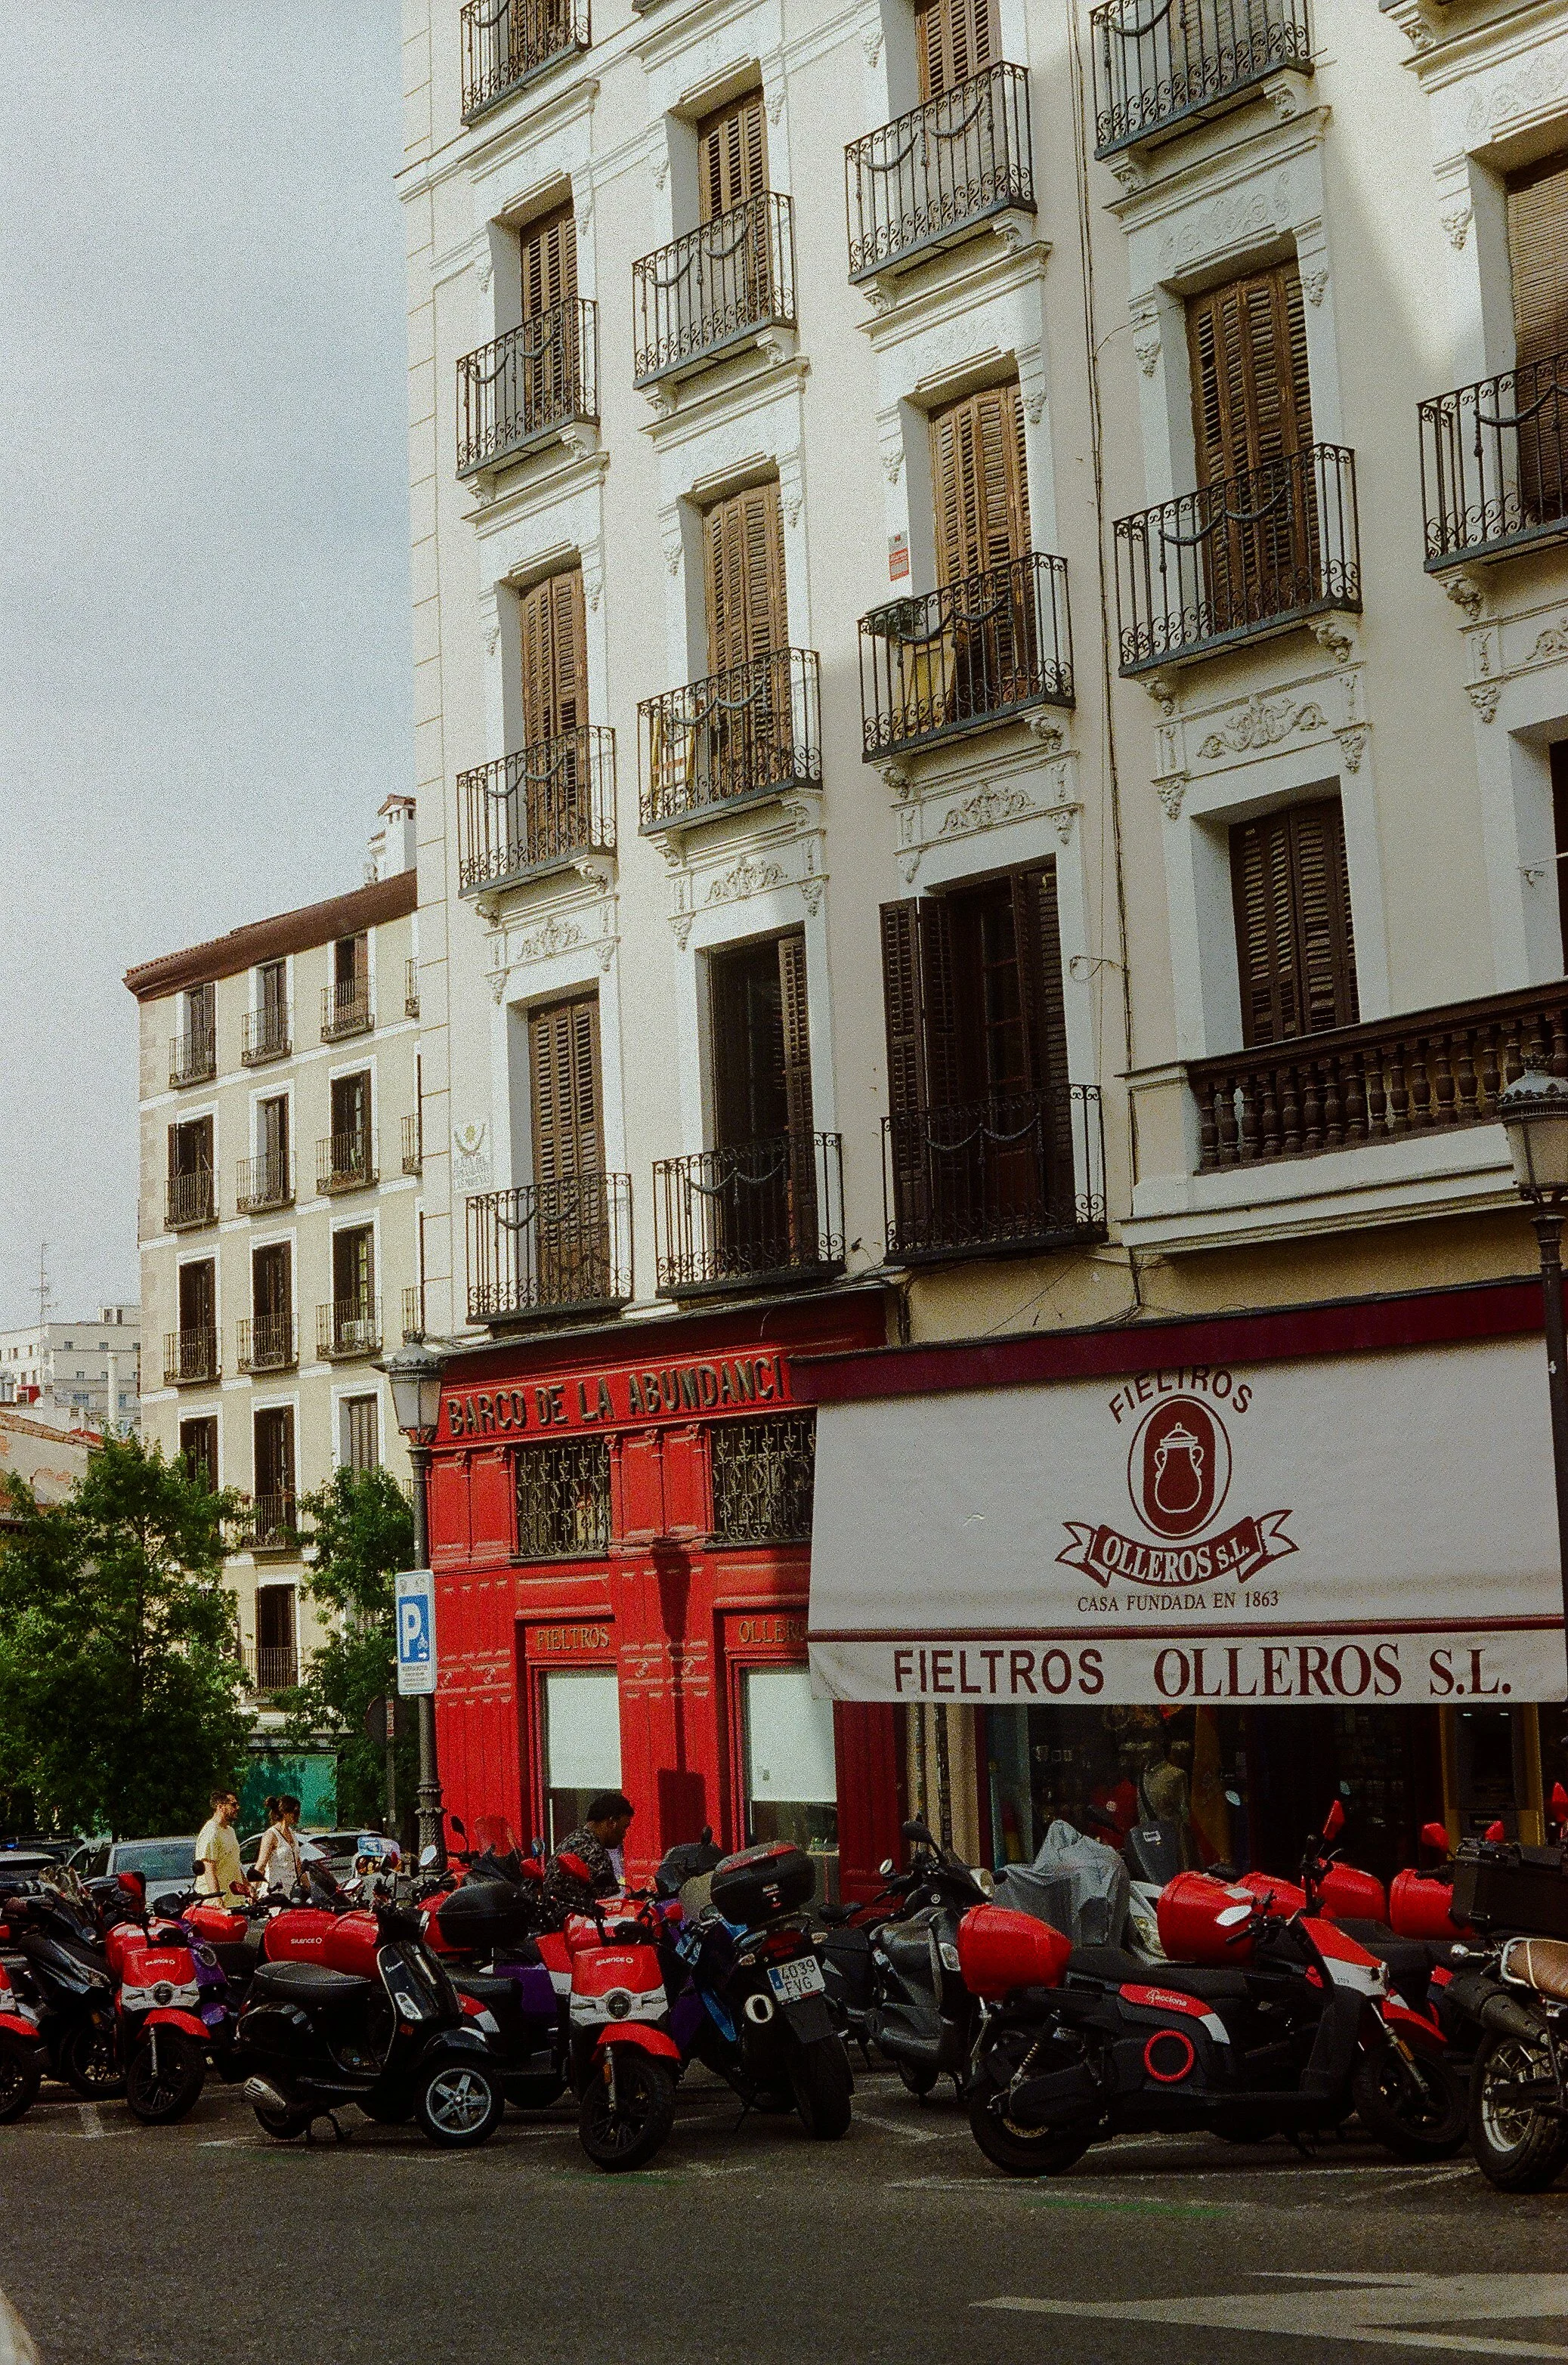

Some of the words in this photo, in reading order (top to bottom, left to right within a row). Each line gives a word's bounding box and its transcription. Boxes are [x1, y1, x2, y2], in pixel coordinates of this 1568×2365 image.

[447, 1390, 526, 1436] BARCO
[535, 1385, 568, 1425] DE
[578, 1377, 616, 1423] LA
[628, 1355, 784, 1415] ABUNDANCI
[1109, 1365, 1252, 1424] FIELTROS
[1103, 1536, 1212, 1583] OLLEROS
[1216, 1537, 1251, 1570] S.L.
[1078, 1596, 1119, 1612] CASA
[1127, 1594, 1206, 1611] FUNDADA
[1213, 1592, 1236, 1608] EN
[1245, 1590, 1279, 1607] 1863
[401, 1603, 422, 1658] P
[537, 1627, 609, 1650] FIELTROS
[893, 1648, 1106, 1696] FIELTROS
[1153, 1641, 1403, 1699] OLLEROS
[1428, 1647, 1513, 1696] S.L.
[782, 1959, 816, 1979] 4039
[784, 1977, 813, 1995] FVG
